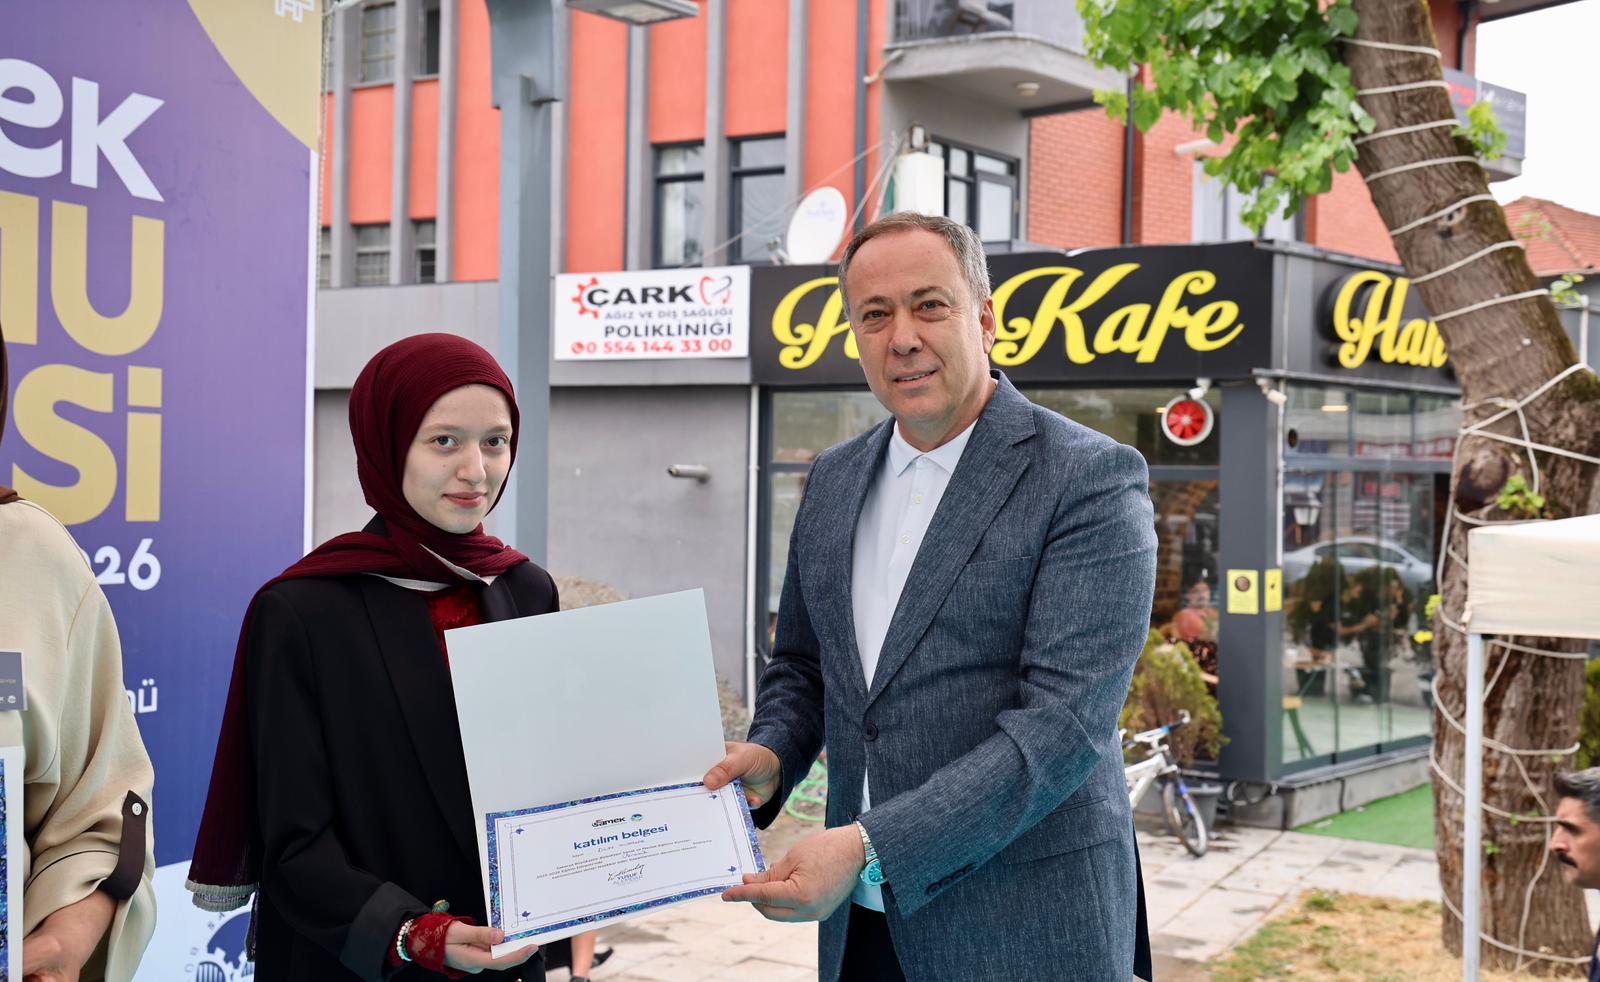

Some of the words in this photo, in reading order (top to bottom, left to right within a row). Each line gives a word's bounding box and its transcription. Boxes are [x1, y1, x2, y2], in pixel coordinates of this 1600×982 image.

[605, 309, 634, 320] AĞIZ
[640, 310, 652, 319] VE
[658, 308, 677, 320] DİŞ
[683, 307, 733, 318] SAĞLIĞI
[991, 263, 1245, 366] Kafe
[605, 319, 732, 338] POLİKLİNİĞİ
[586, 341, 597, 354] 0
[603, 341, 636, 354] 554
[642, 340, 674, 353] 144
[681, 339, 702, 353] 33
[708, 339, 732, 353] 00
[81, 538, 161, 591] 26
[573, 836, 618, 850] katılım
[622, 823, 668, 839] belgesi
